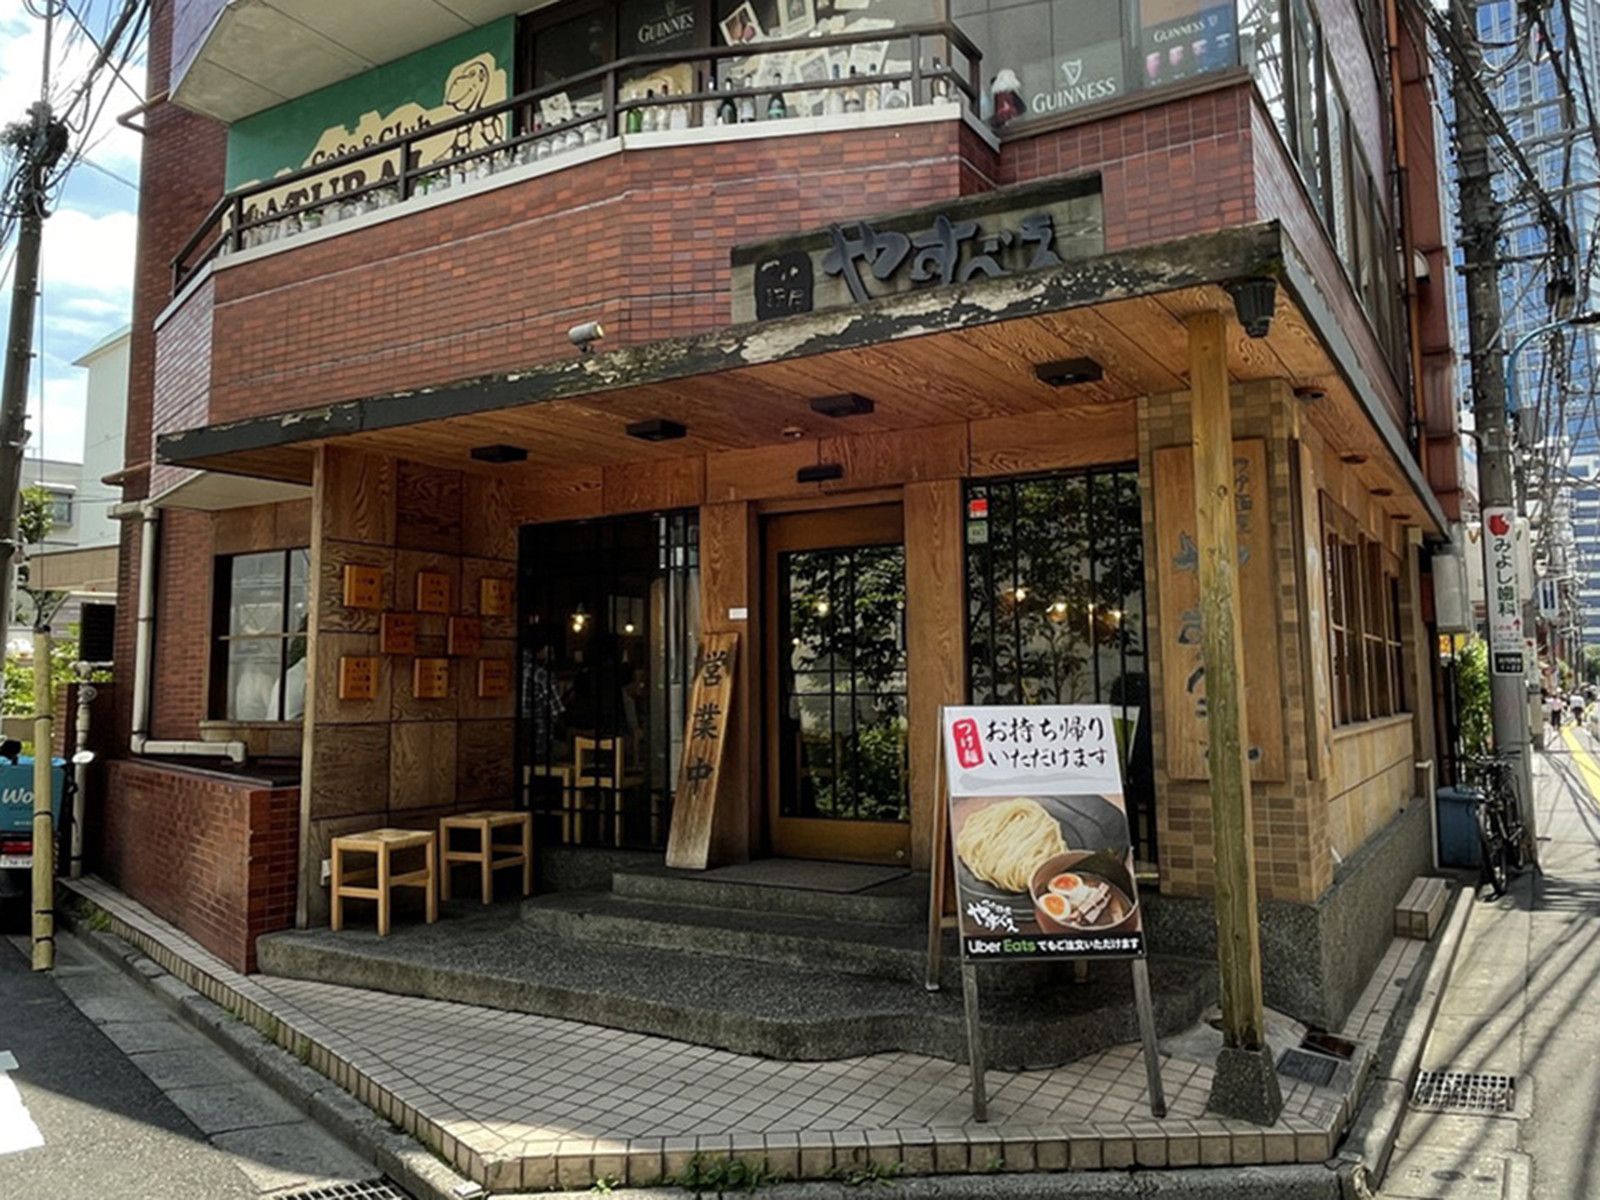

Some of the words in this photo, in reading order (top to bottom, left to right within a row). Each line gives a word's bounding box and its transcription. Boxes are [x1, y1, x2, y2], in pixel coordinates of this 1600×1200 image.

[1031, 77, 1117, 114] GUINNESS
[822, 212, 1064, 302] やすべえ
[1493, 537, 1516, 617] みよし歯科
[685, 651, 728, 794] 営業中
[985, 715, 1105, 744] お持ち帰り
[987, 747, 1108, 769] いただけます
[968, 939, 1001, 954] Uber
[1003, 938, 1036, 953] Eats
[1037, 937, 1140, 952] でもご注文いただけます
